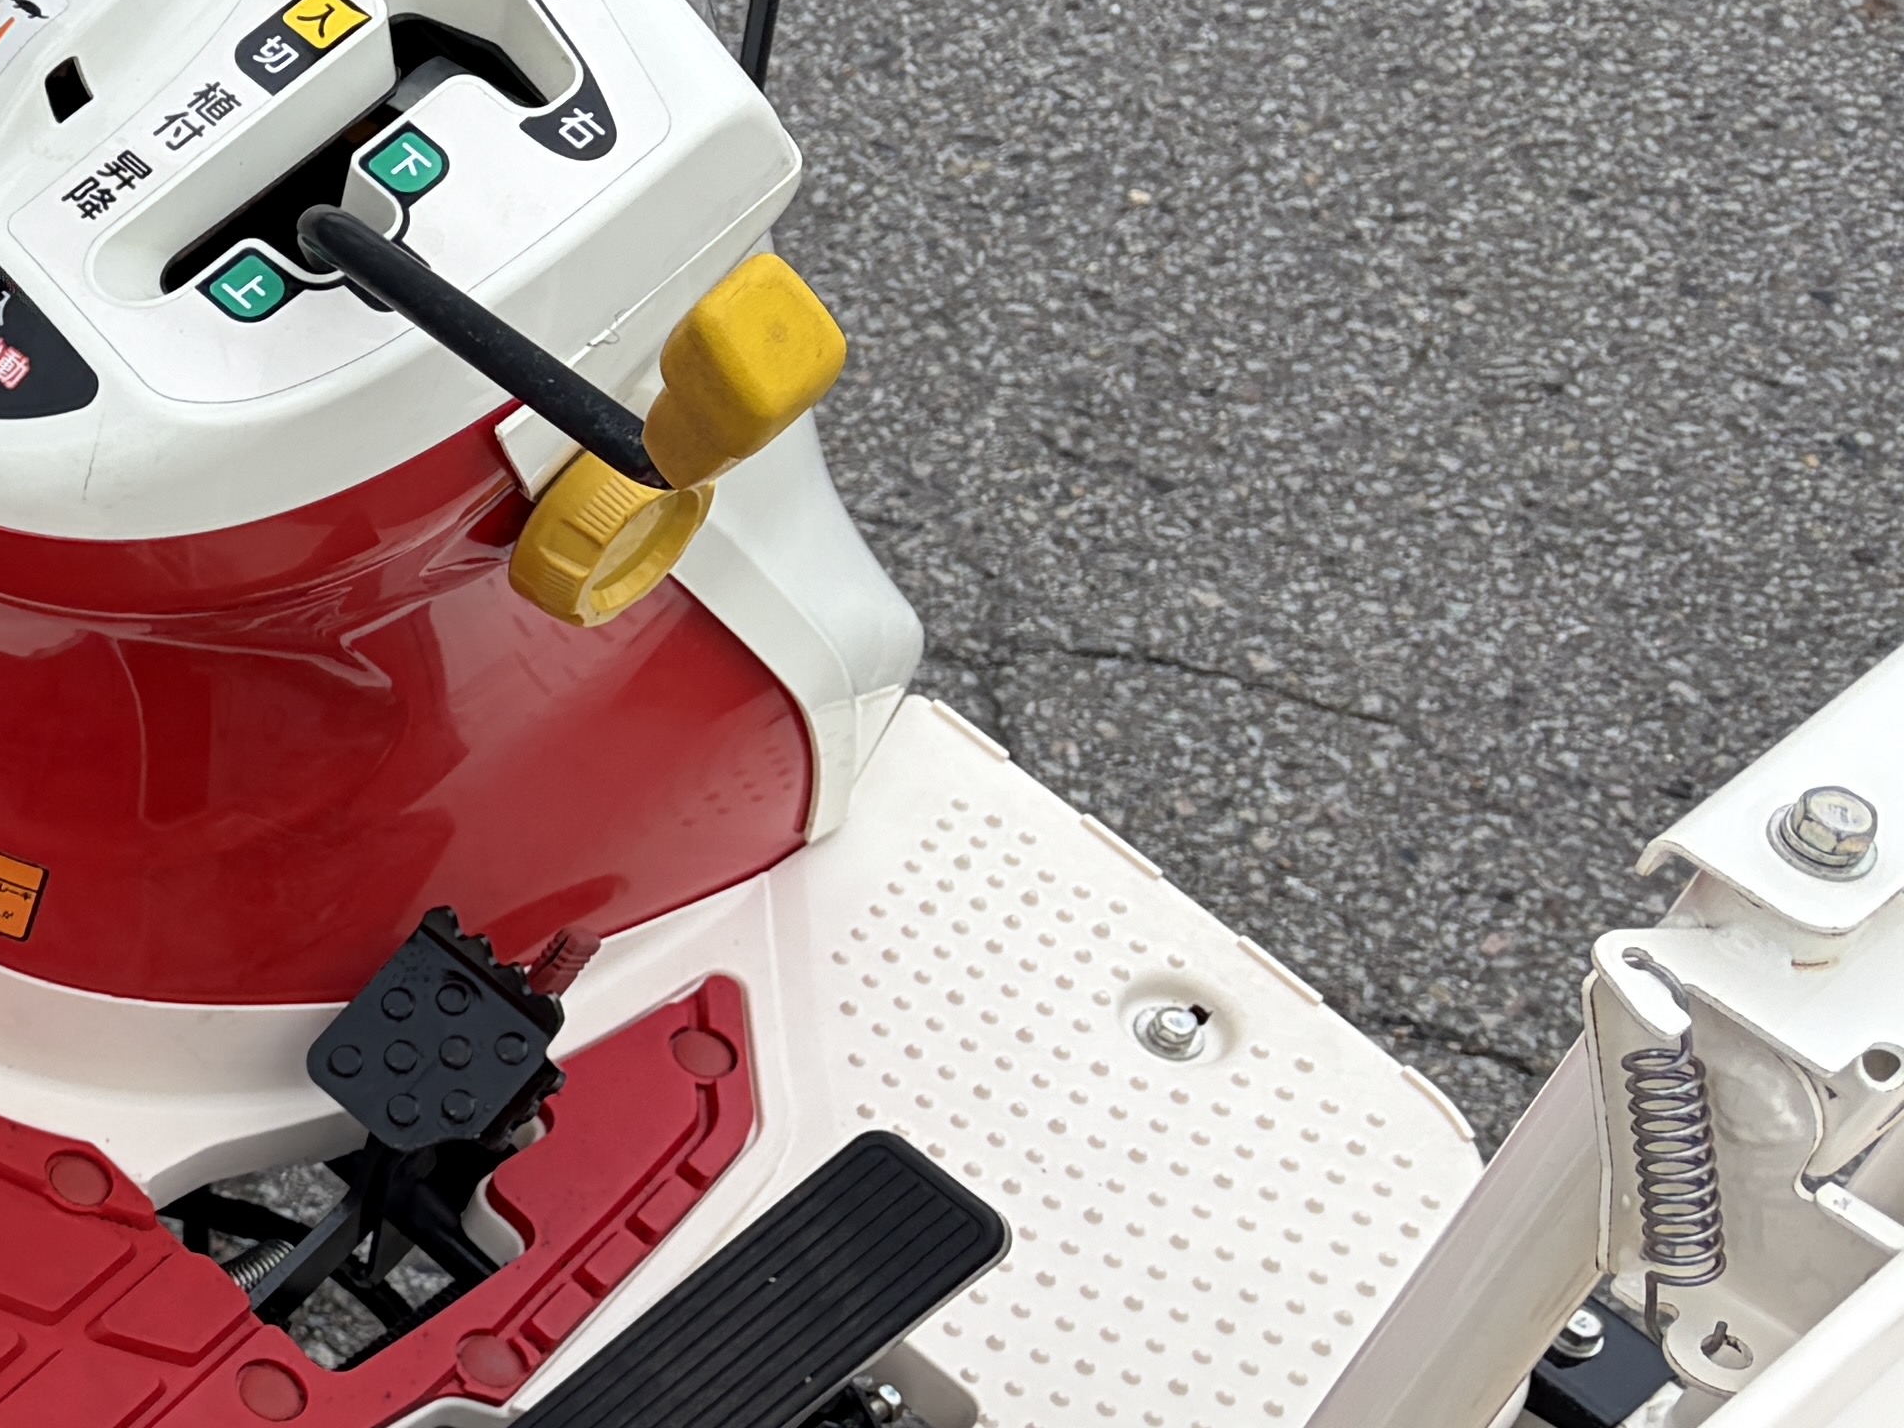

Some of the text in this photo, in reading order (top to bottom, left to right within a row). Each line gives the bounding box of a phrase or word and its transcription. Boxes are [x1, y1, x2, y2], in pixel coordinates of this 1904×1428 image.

[296, 3, 333, 38] 入
[251, 35, 301, 75] 切
[153, 82, 242, 151] 植付
[557, 103, 606, 149] 右
[388, 142, 433, 178] 下
[61, 149, 153, 220] 昇降
[222, 272, 268, 309] 上
